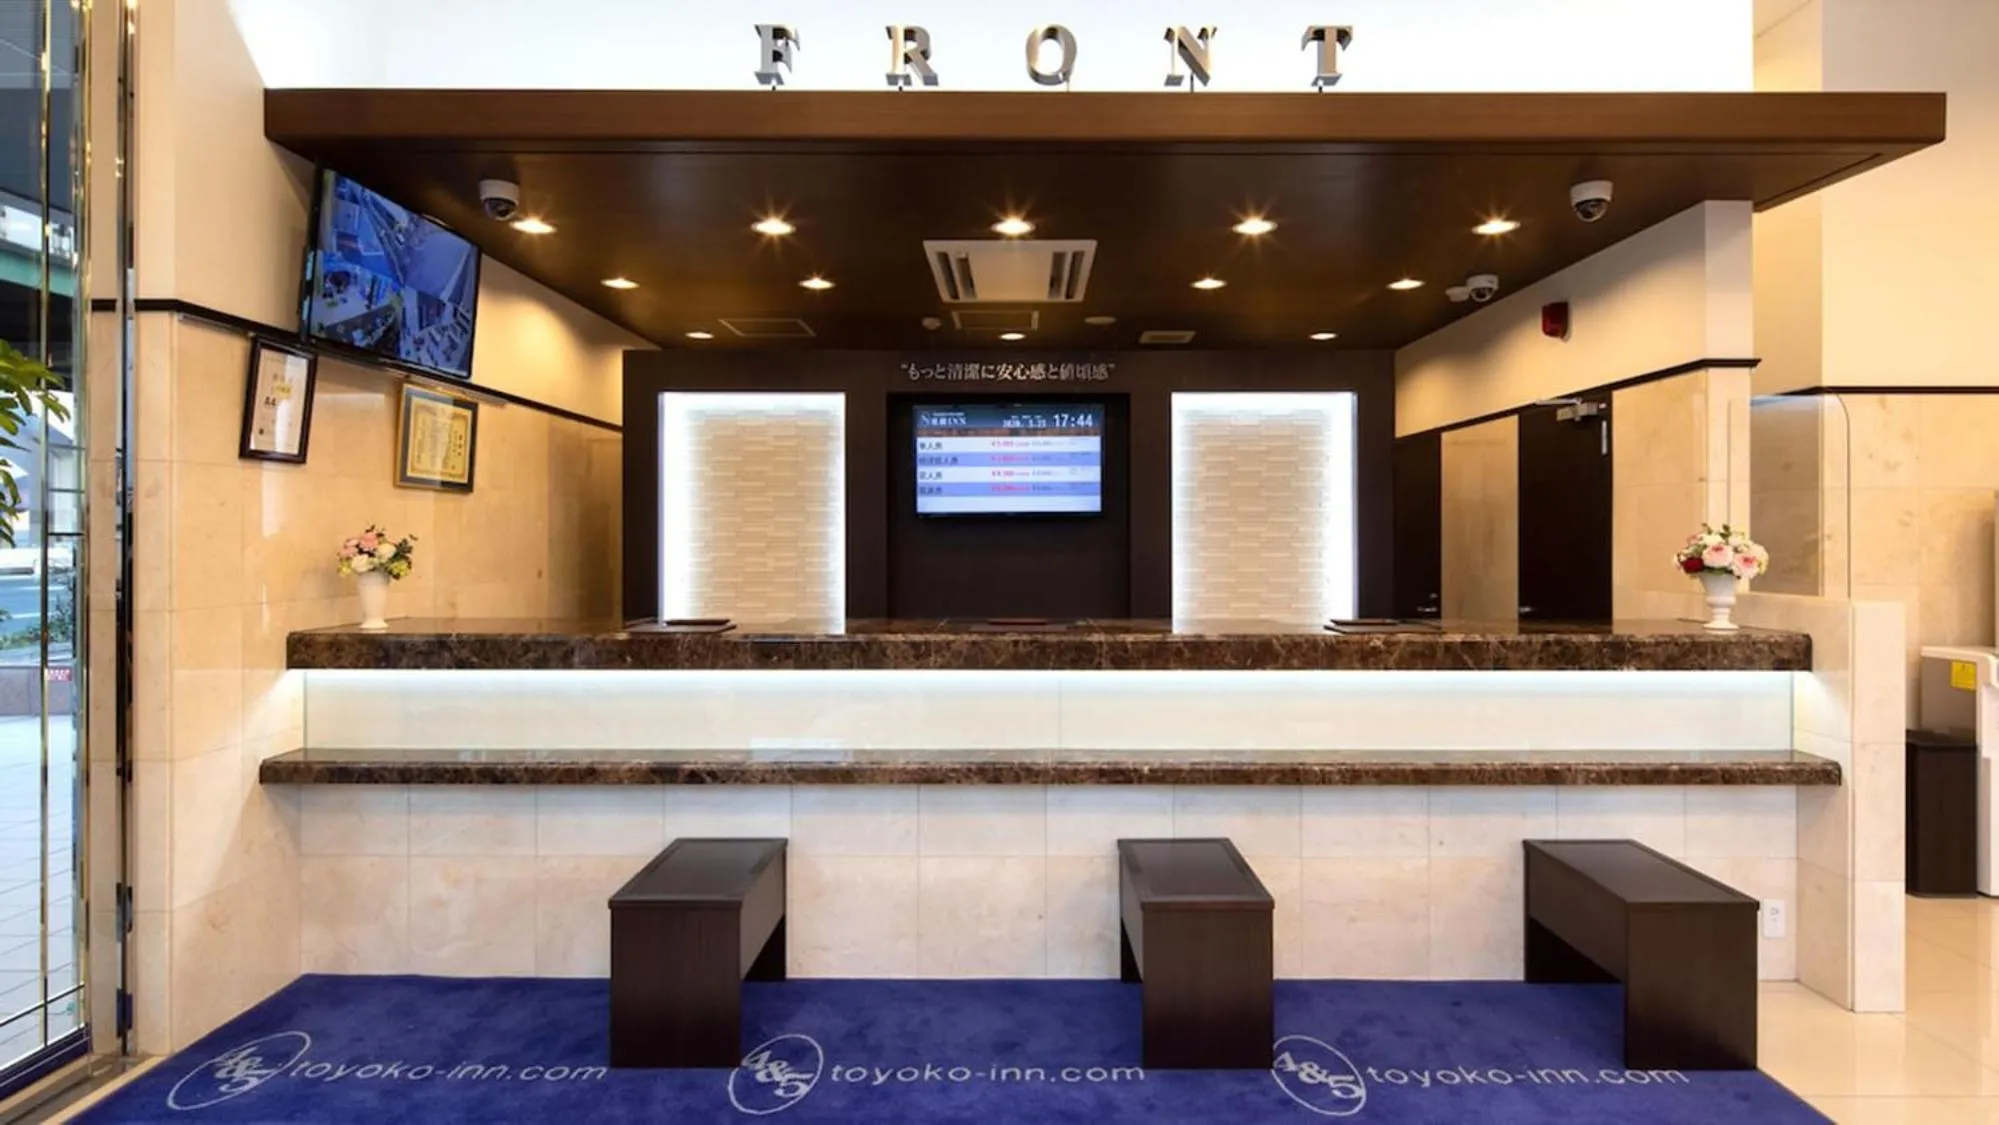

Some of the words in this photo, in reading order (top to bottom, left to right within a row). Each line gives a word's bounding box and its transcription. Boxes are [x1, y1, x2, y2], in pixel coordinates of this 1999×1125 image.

[753, 24, 1354, 86] FRONT
[1054, 413, 1094, 428] 17:44
[289, 1060, 606, 1082] toyoko-inn.com
[831, 1065, 1145, 1085] toyoko-inn.com
[1367, 1066, 1690, 1088] toyoko-inn.com
